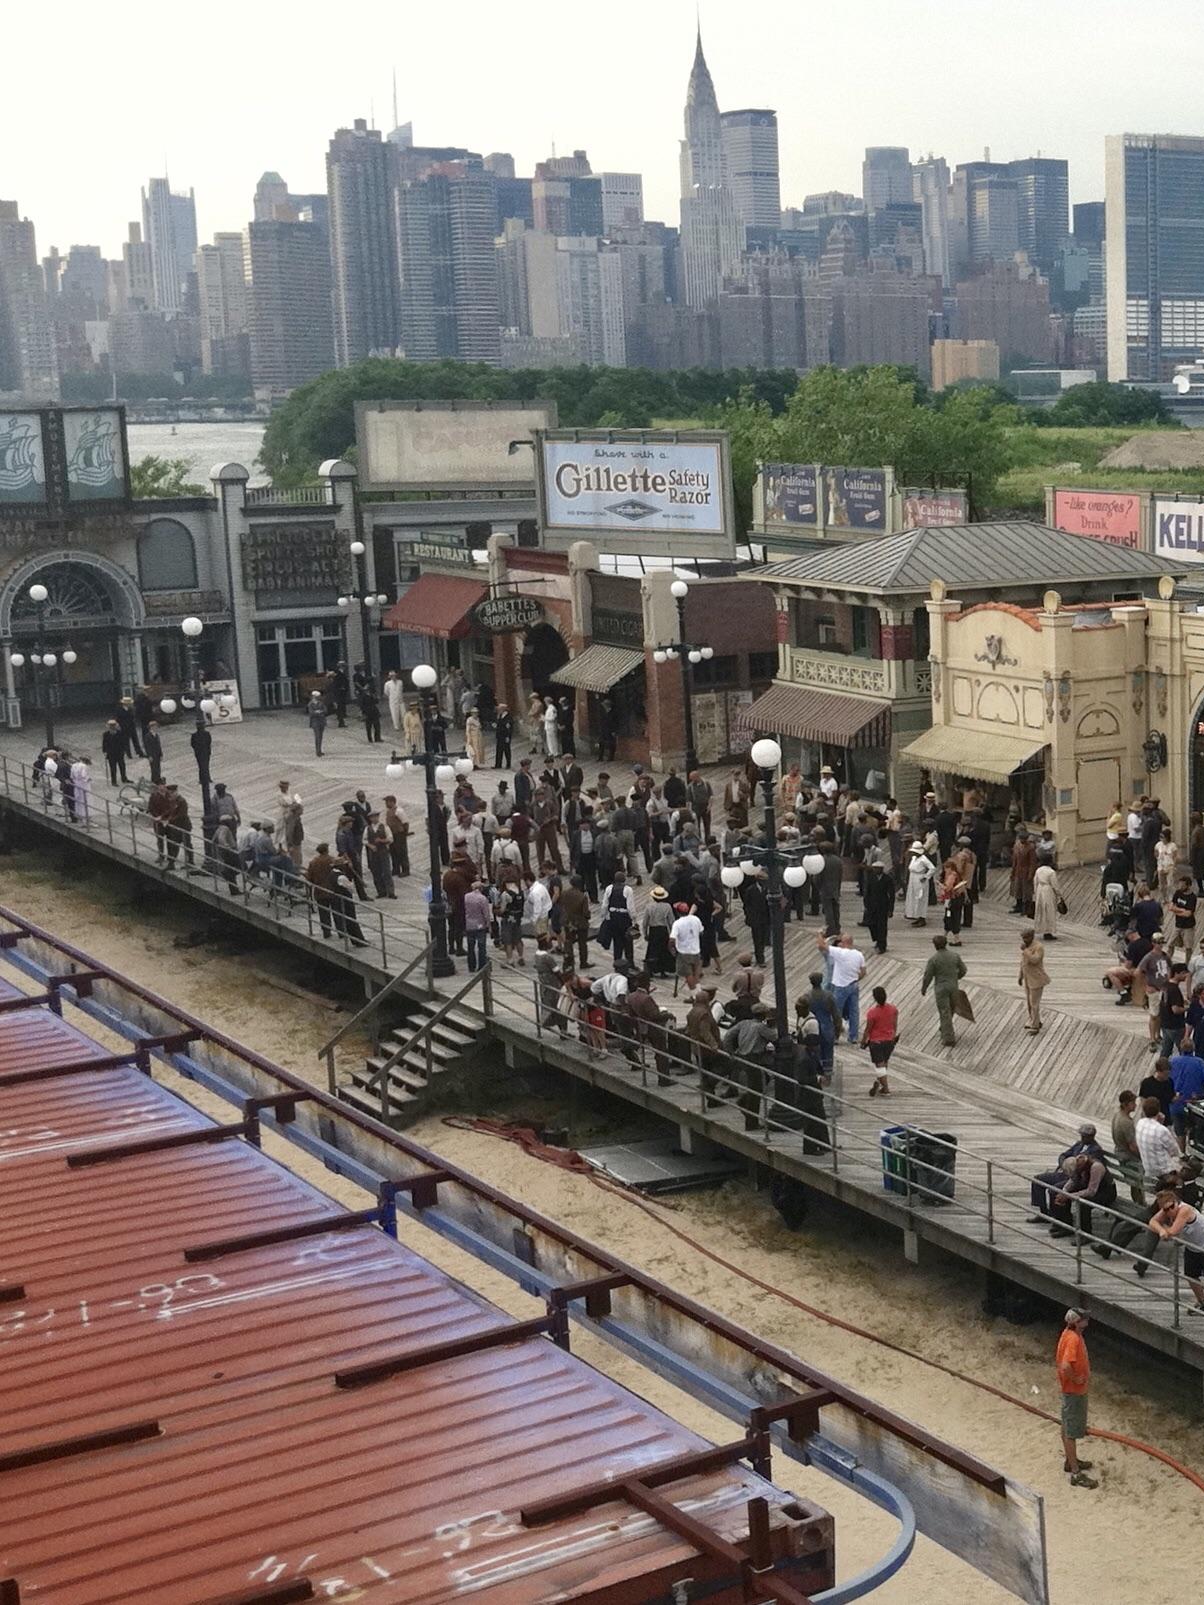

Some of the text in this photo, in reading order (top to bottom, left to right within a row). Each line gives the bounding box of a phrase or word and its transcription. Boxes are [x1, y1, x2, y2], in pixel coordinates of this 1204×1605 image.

[631, 450, 655, 459] with
[555, 463, 666, 499] Gillette
[669, 469, 709, 490] Safety
[780, 476, 816, 488] California
[843, 478, 882, 491] California
[669, 487, 711, 505] Razor
[920, 504, 962, 518] California
[1081, 515, 1108, 529] Drink
[413, 543, 469, 563] RESTAURANT
[485, 599, 537, 616] BABETTES
[483, 614, 517, 626] SUPPER
